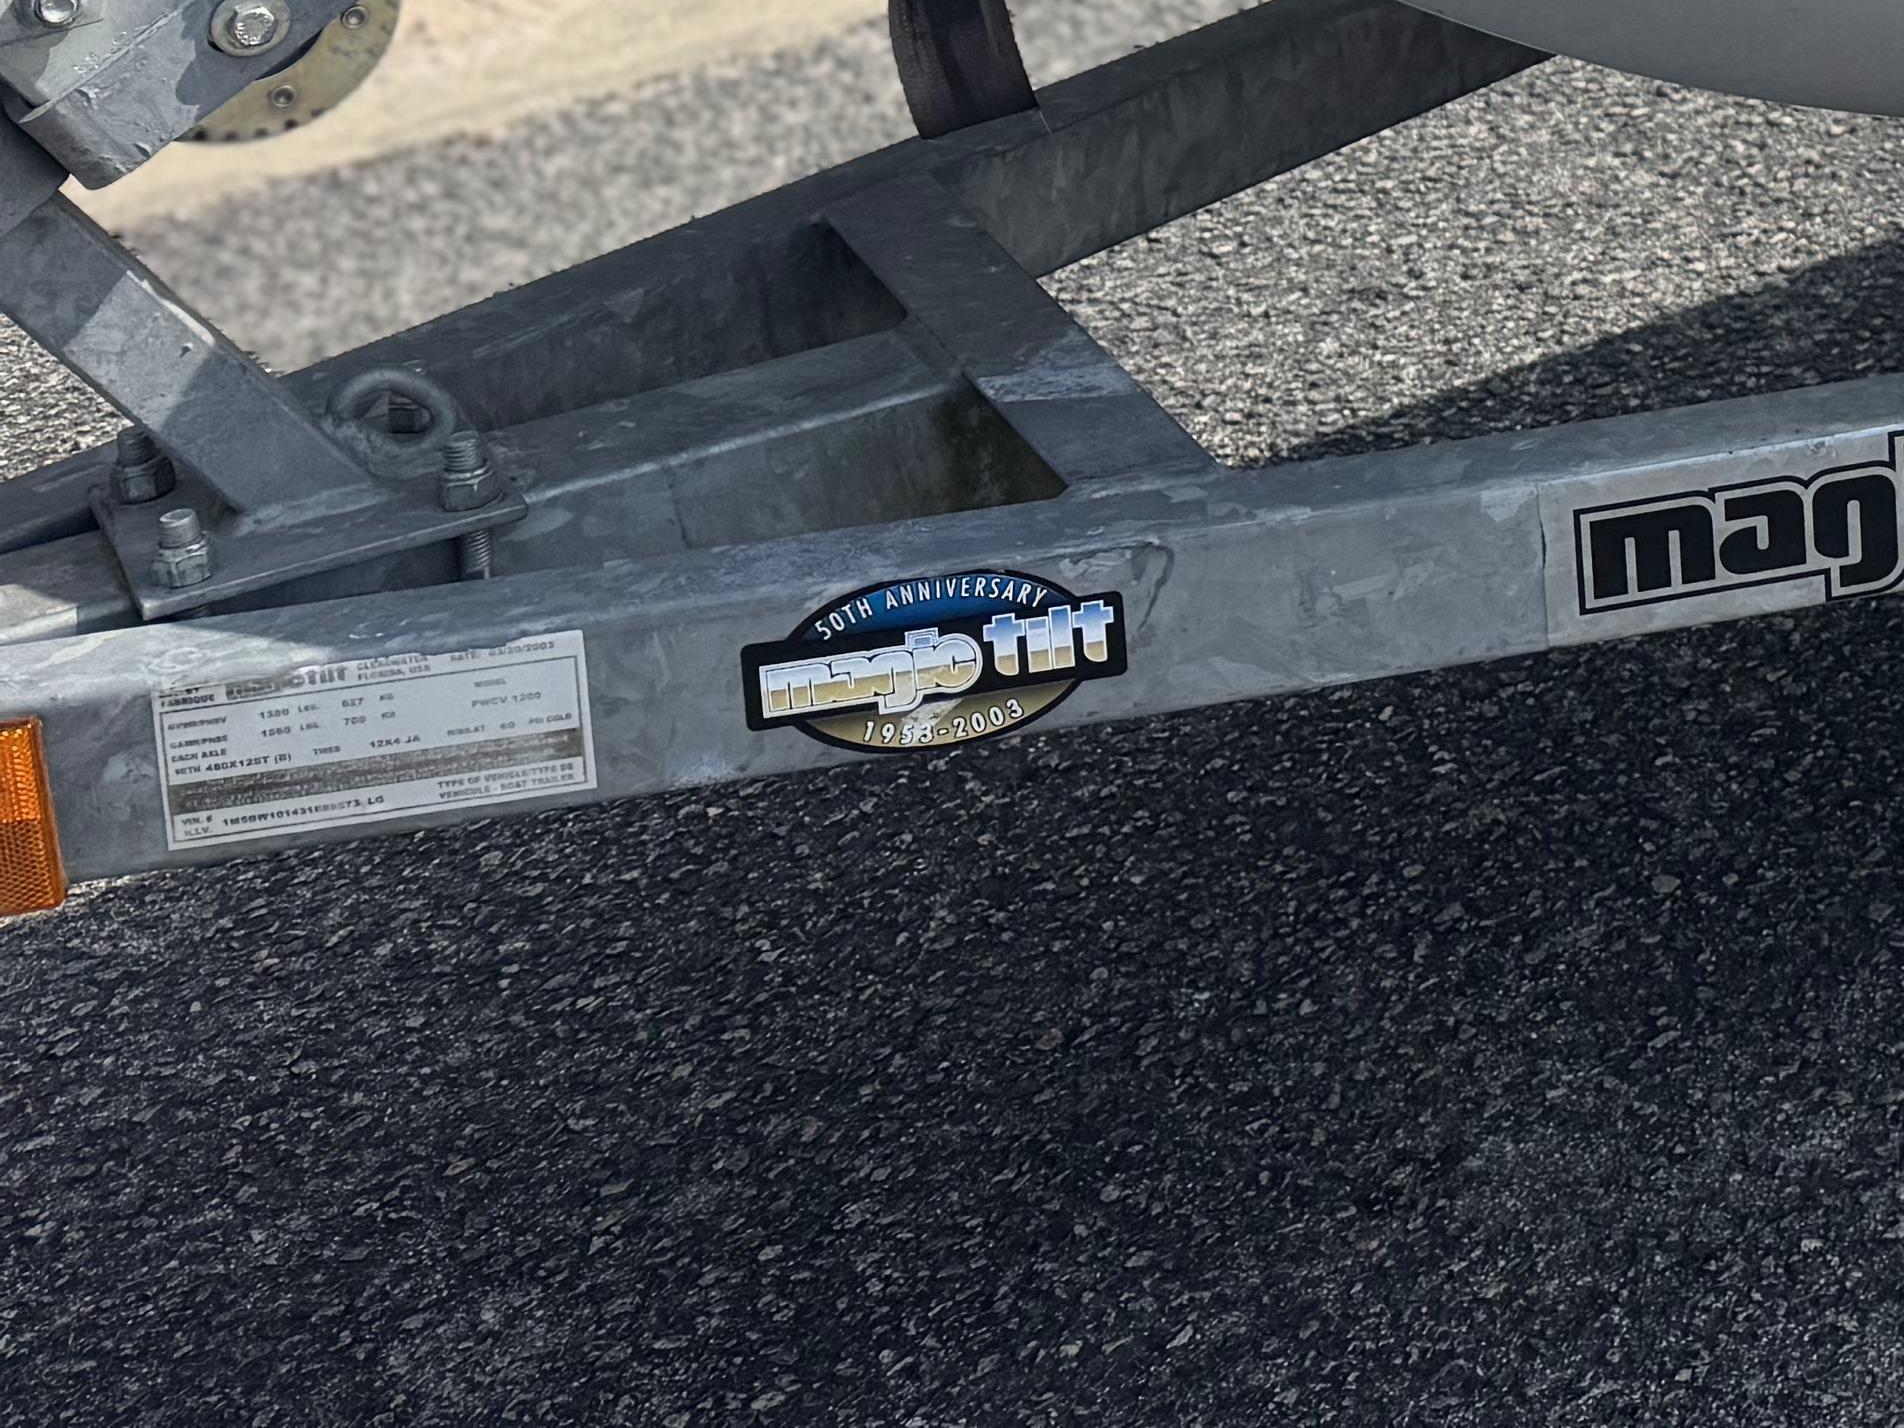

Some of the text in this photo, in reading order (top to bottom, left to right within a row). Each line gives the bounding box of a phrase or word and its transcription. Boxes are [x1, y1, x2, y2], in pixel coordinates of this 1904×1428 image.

[814, 576, 1048, 641] 50TH ANNIVERSARY
[863, 698, 1024, 745] 1953-2003
